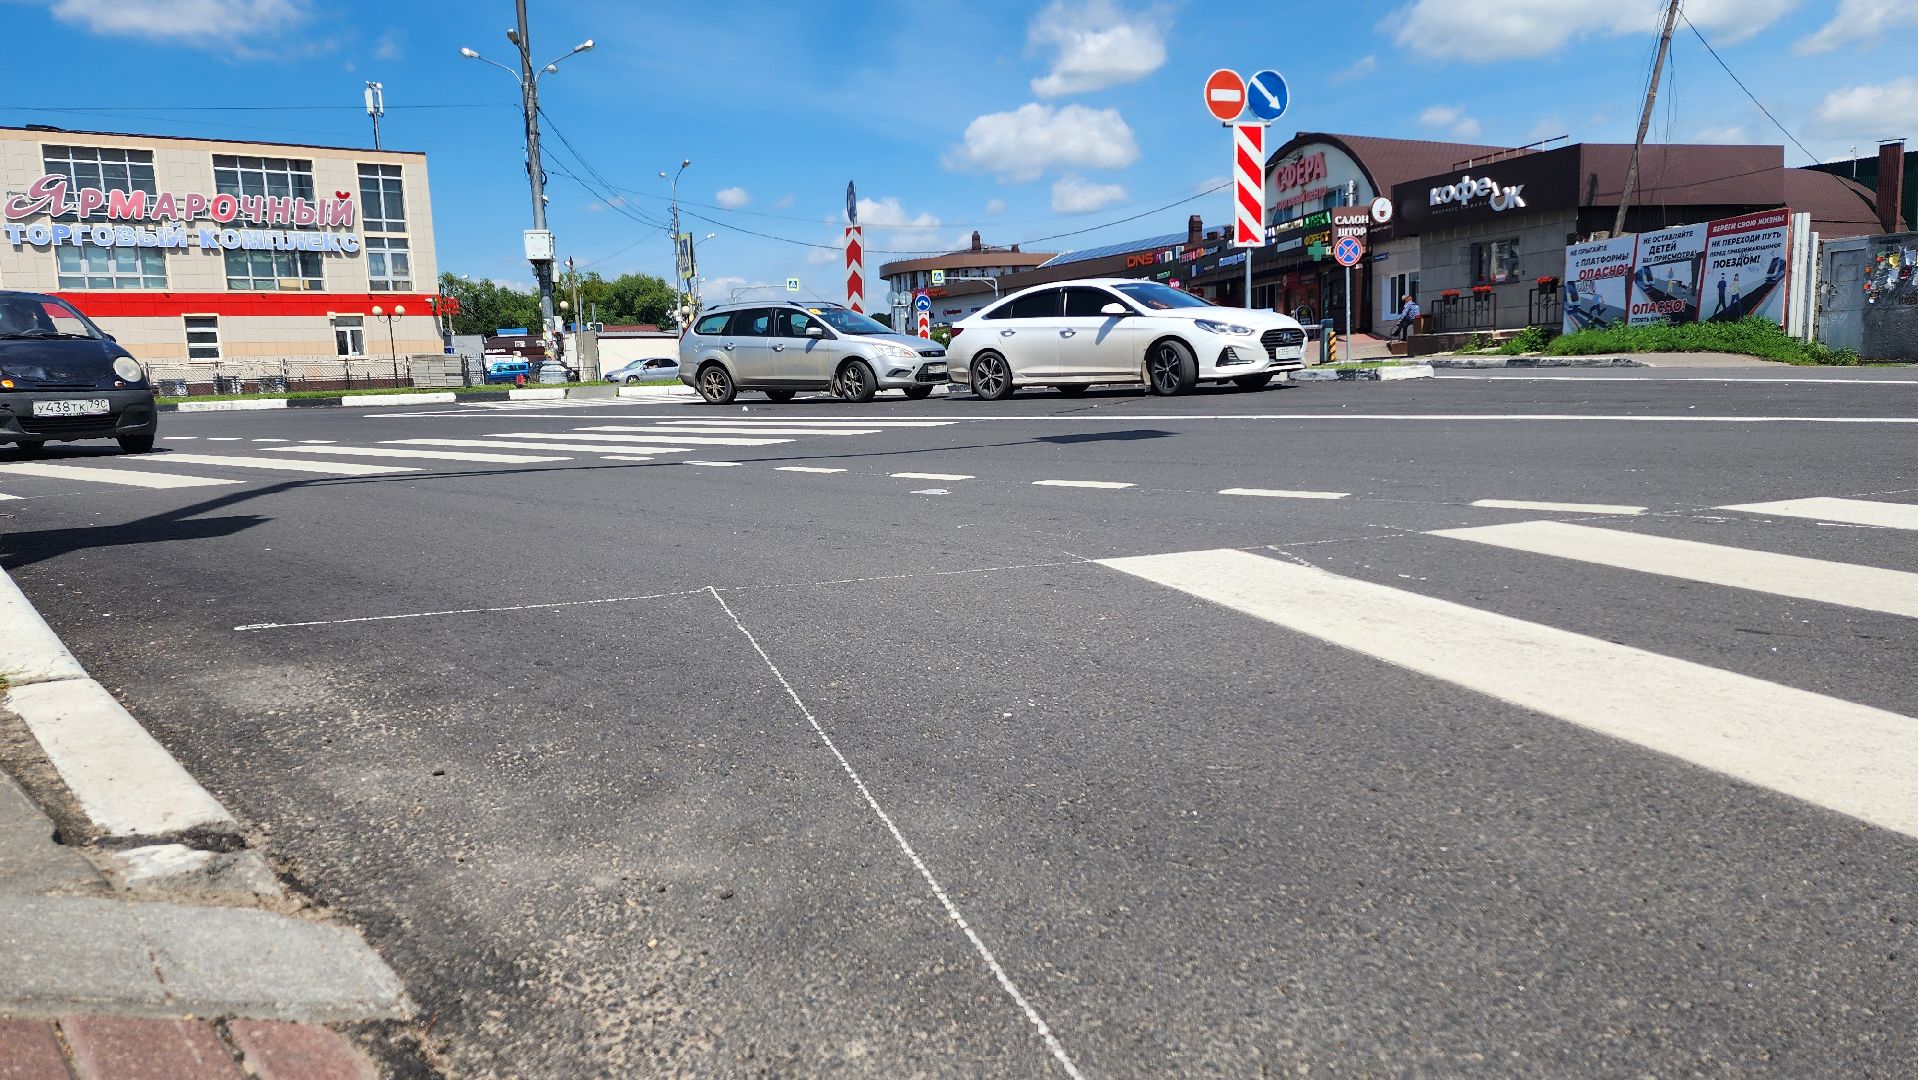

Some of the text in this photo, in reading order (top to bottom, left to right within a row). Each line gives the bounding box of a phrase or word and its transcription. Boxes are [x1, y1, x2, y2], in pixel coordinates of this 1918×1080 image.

[1274, 152, 1327, 192] СФЕРА
[1430, 175, 1492, 206] кофе
[1334, 215, 1369, 225] САЛОН
[1712, 214, 1785, 233] БЕРЕГИ СВОЮ ЖИЗНЬ!
[3, 221, 360, 253] ТОРГОВЫЙ КОМПЛЕКС
[1337, 226, 1367, 238] ШТОР
[1643, 230, 1694, 245] НЕ ОСТАВЛЯЙТЕ
[1711, 231, 1782, 248] НЕ ПЕРЕХОДИ ПУТЬ
[1570, 244, 1608, 257] НЕ ПРЫГАЙТЕ
[1649, 239, 1677, 256] ДЕТЕЙ
[1653, 249, 1697, 262] ПРИСМОТРА!
[1709, 250, 1726, 258] ПЕРЕД
[1127, 252, 1154, 269] DNS
[1580, 252, 1629, 267] ПЛАТФОРМЫ
[1712, 254, 1761, 270] ПОЕЗДОМ!
[1579, 263, 1630, 281] ОПАСНО!
[1632, 298, 1687, 316] ОПАСНО!
